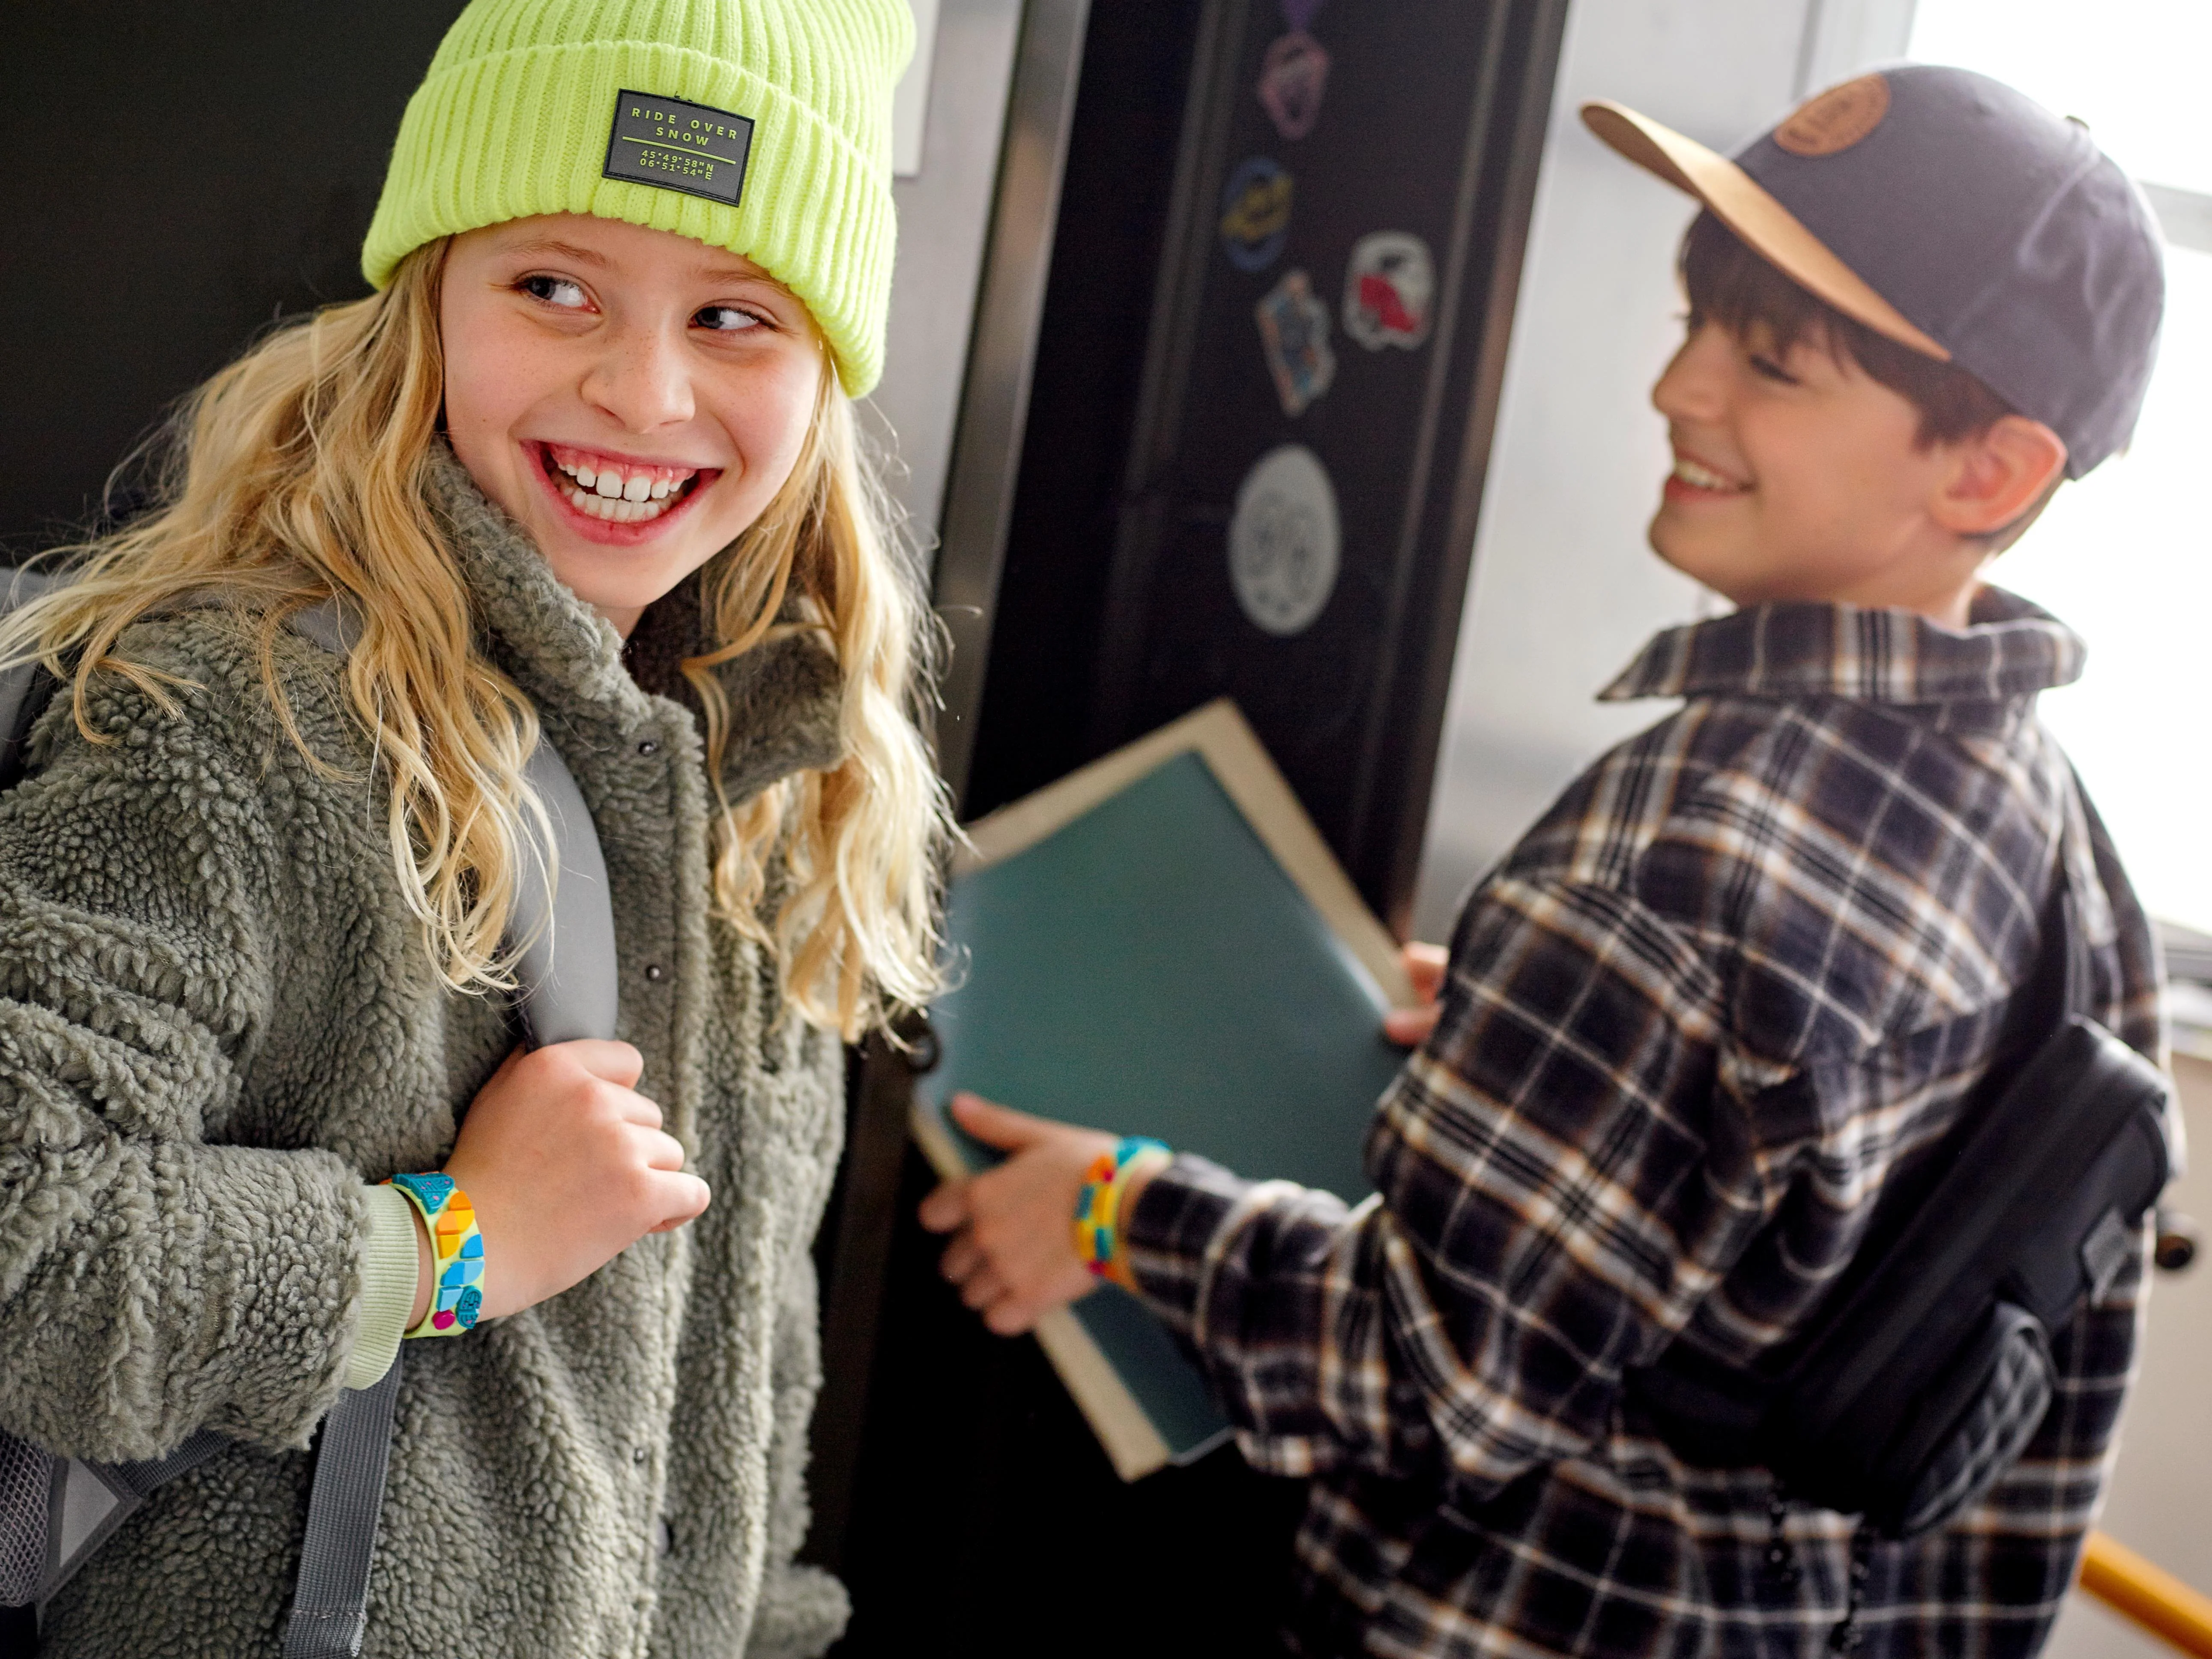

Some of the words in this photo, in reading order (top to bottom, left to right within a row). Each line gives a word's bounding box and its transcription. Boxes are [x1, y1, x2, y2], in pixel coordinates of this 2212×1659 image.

[632, 108, 676, 124] RIDE
[691, 120, 737, 139] OVER
[656, 127, 708, 146] SNOW
